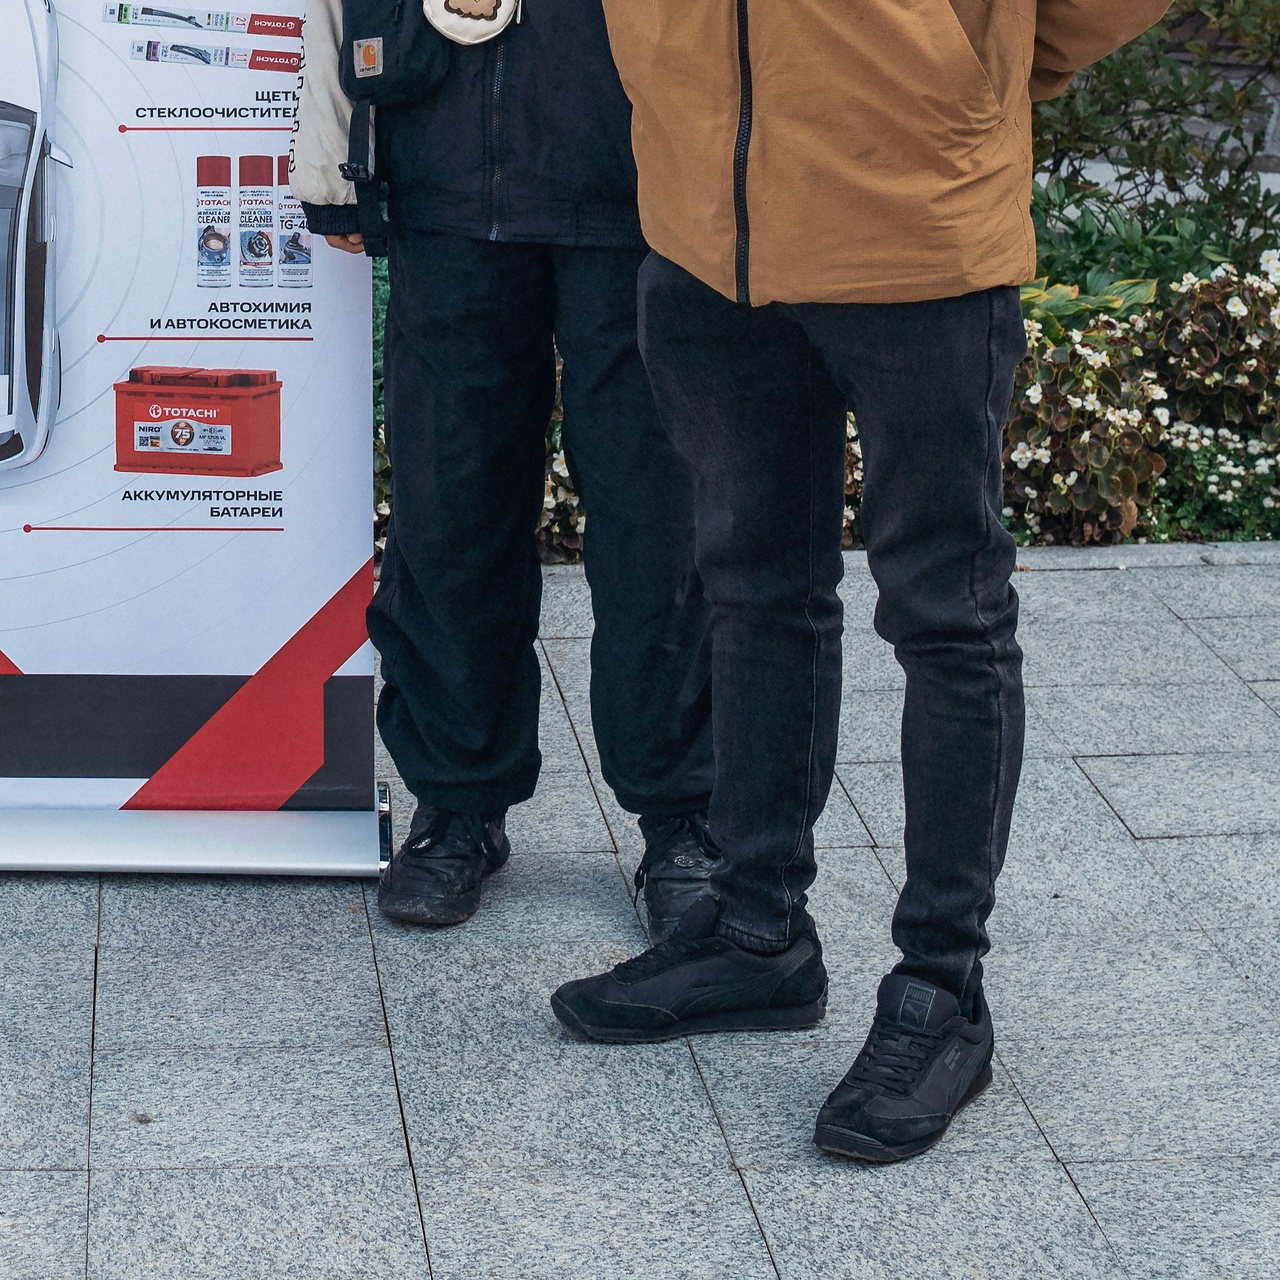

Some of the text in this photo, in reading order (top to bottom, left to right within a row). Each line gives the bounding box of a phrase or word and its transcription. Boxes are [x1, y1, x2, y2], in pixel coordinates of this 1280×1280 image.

[207, 302, 312, 313] АВТОХИМИЯ
[150, 318, 313, 330] И АВТОКОСМЕТИКА
[163, 407, 218, 419] TOTACHI
[174, 428, 191, 439] 75
[121, 490, 283, 502] АККУМУЛЯТОРНЫЕ
[210, 506, 283, 518] БАТАРЕИ
